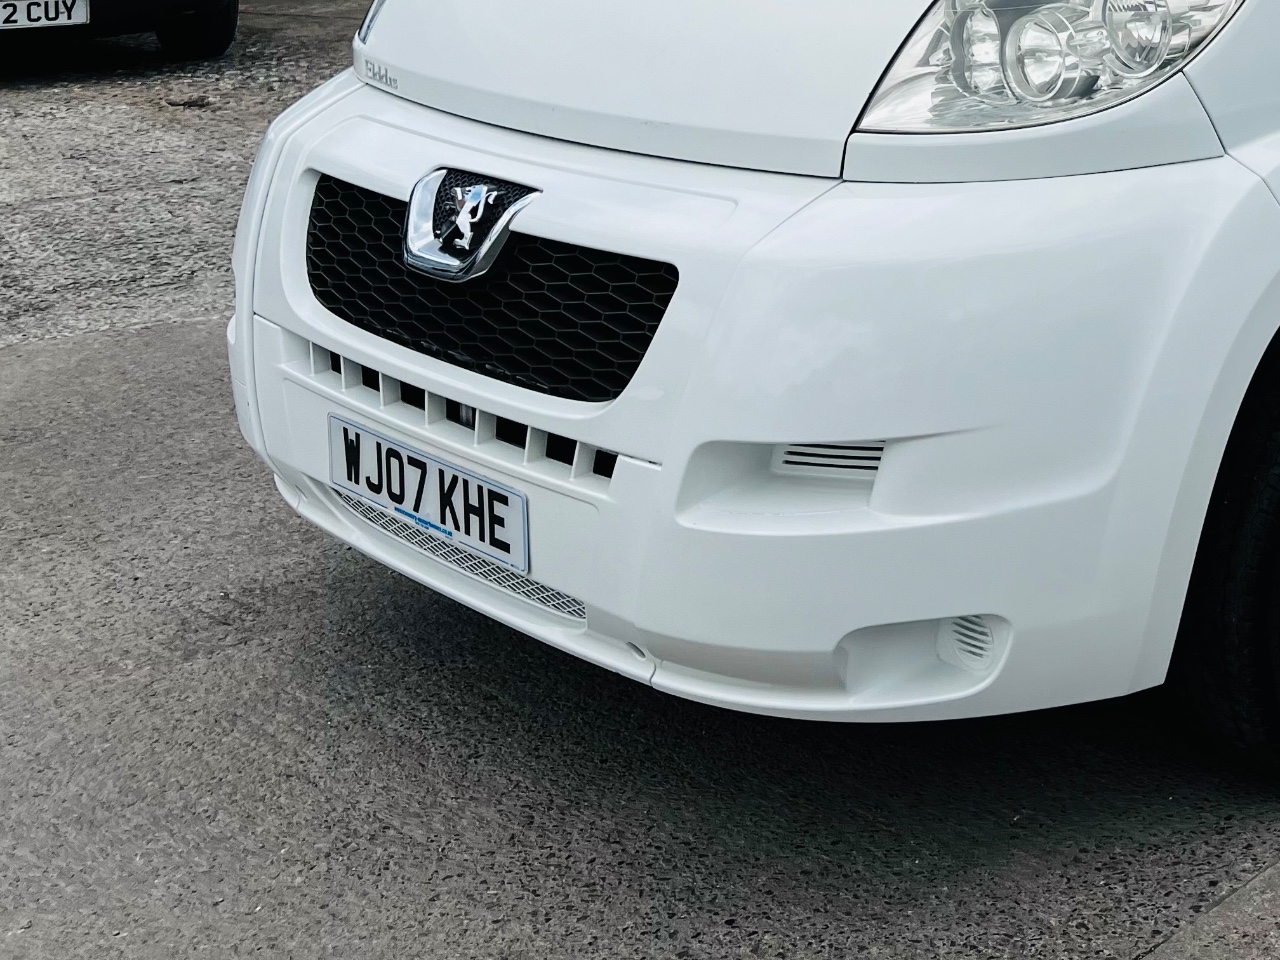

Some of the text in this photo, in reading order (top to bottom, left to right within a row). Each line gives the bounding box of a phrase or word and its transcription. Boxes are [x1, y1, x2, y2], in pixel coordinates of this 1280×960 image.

[2, 0, 77, 25] 2 CUY
[342, 426, 511, 555] WJ07 KHE
